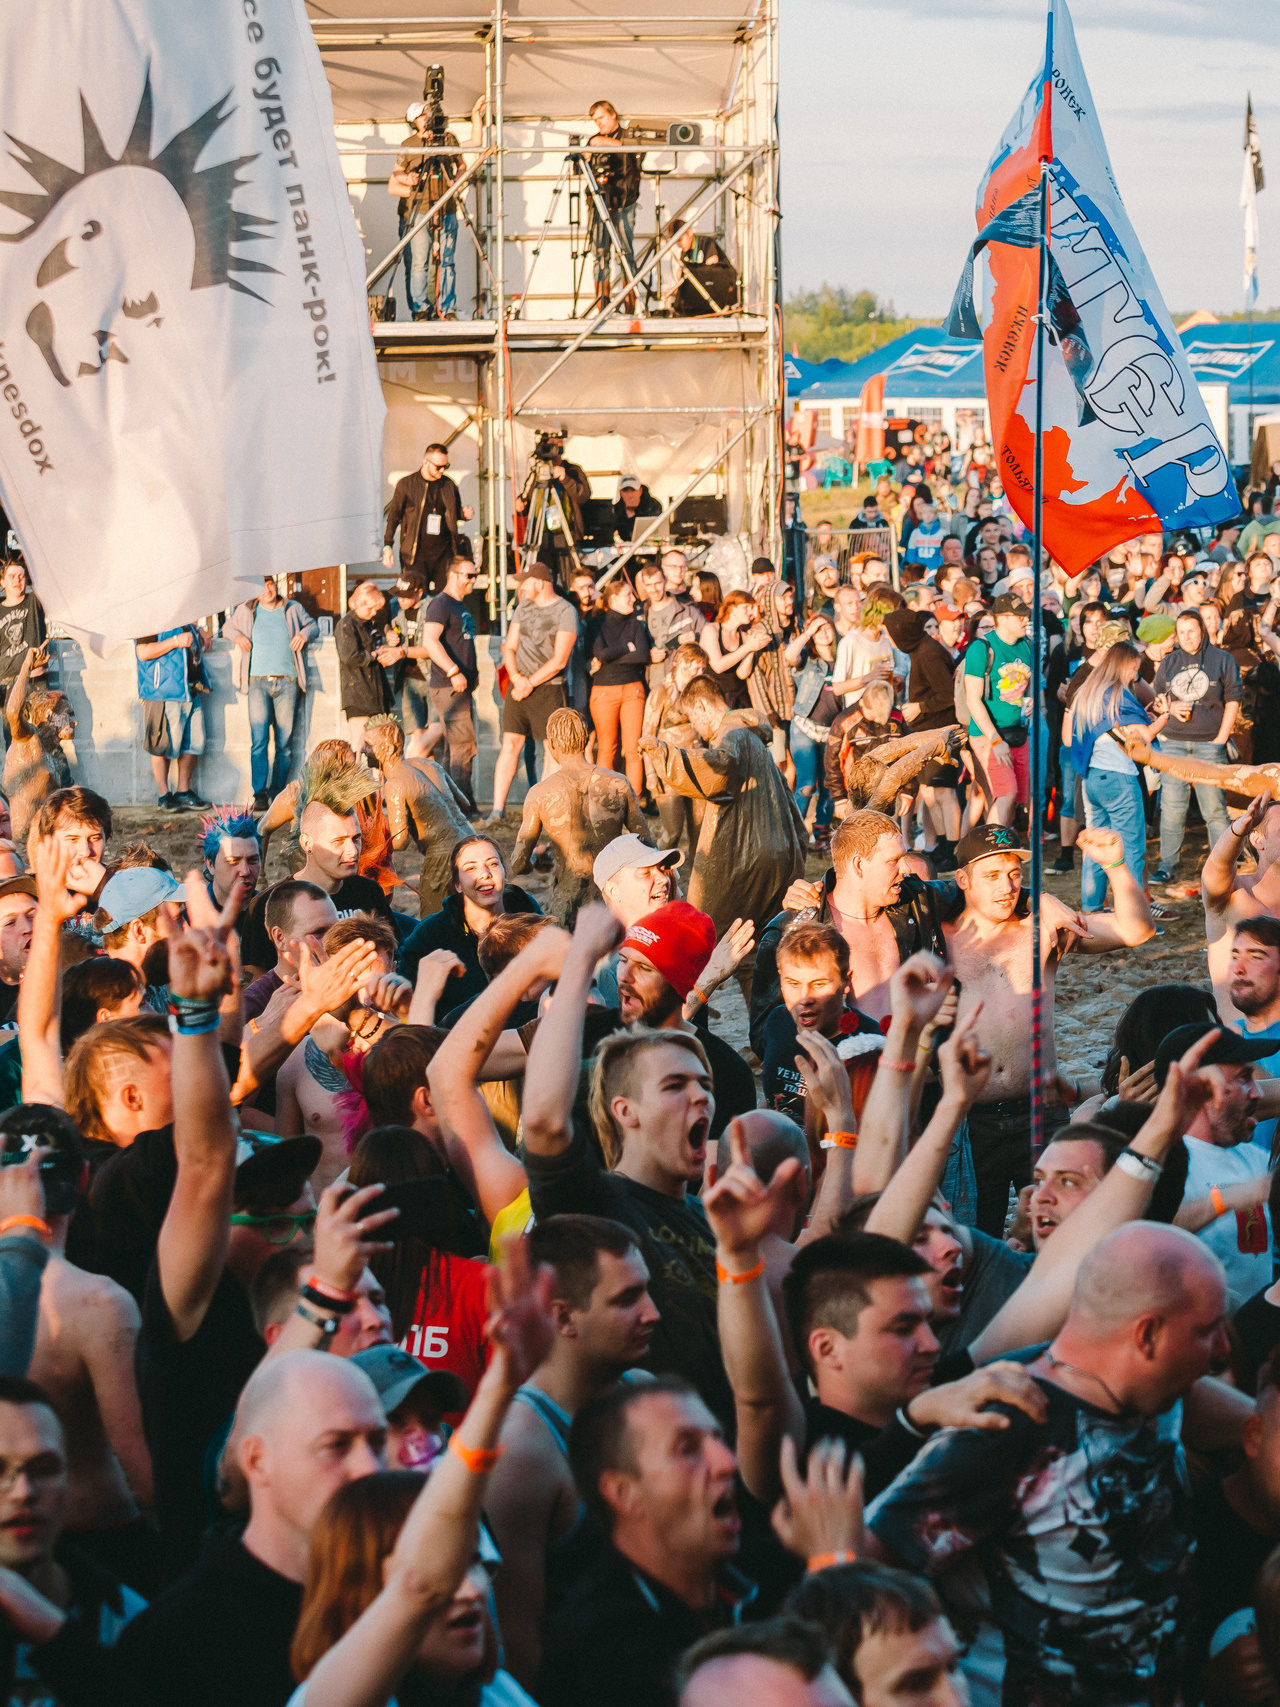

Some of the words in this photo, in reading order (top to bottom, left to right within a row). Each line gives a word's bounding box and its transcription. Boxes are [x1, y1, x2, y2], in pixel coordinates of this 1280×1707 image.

[253, 57, 299, 169] будет
[285, 183, 337, 386] панк-рок!
[0, 340, 55, 477] nesdox
[1002, 444, 1051, 506] ТОЛЬЯТИ
